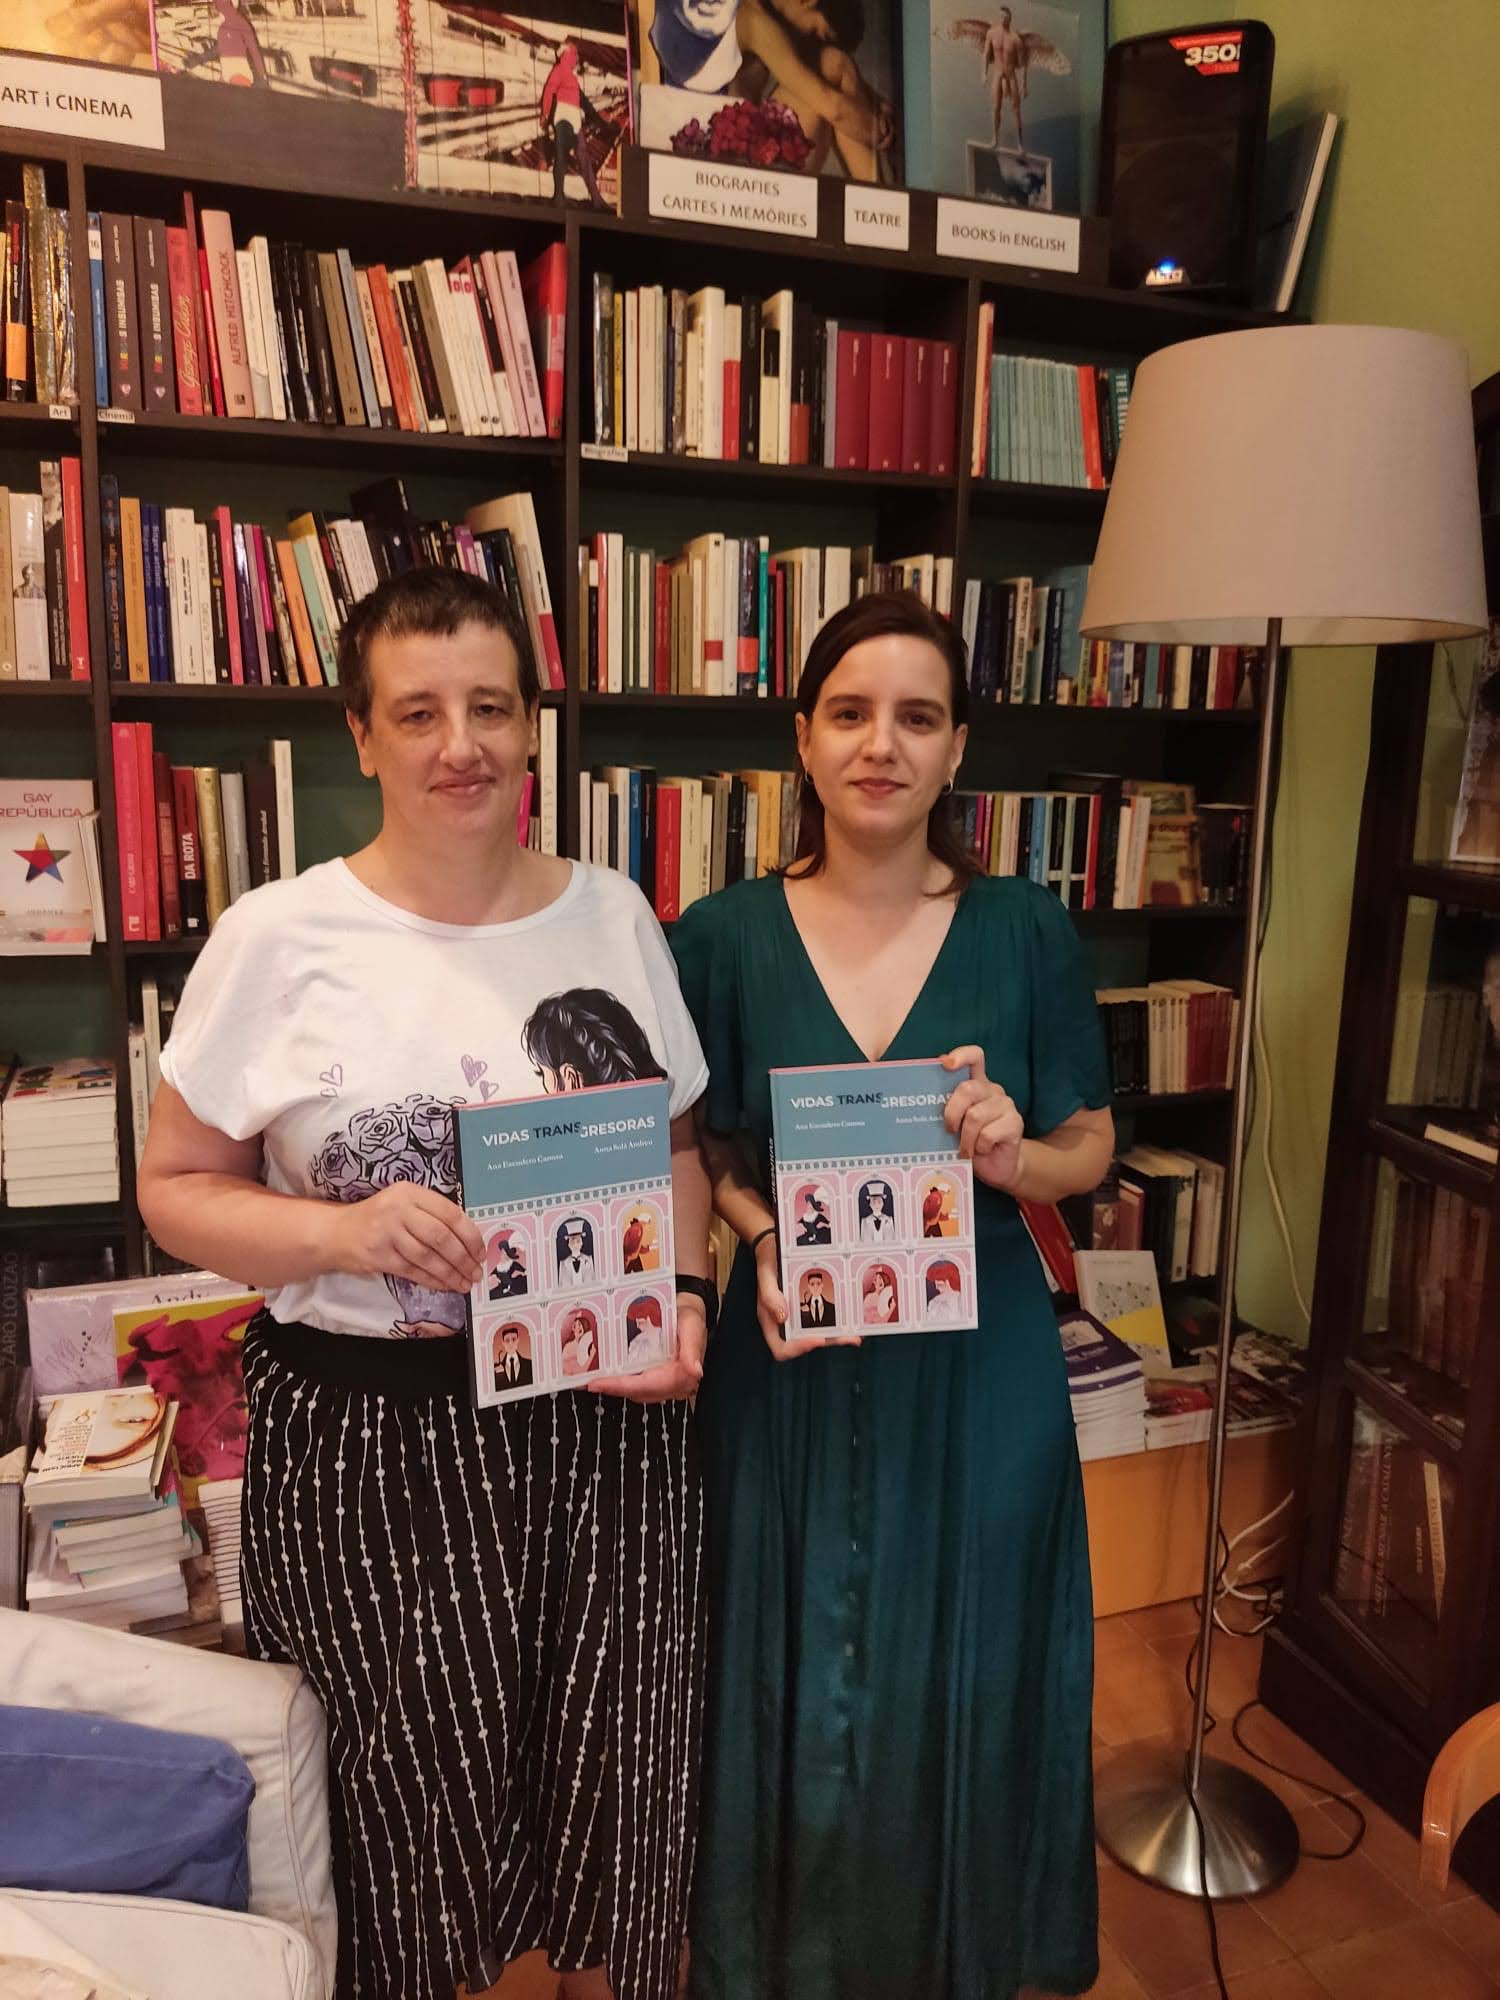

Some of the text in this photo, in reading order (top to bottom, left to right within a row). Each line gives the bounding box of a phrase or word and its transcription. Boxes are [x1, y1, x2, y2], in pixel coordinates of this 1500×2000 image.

[1184, 43, 1241, 67] 350
[1, 86, 133, 119] ART i CINEMA
[695, 170, 780, 197] BIOGRAFIES
[662, 194, 808, 228] CARTES I MEMÒRIES
[853, 209, 902, 228] TEATRE
[951, 224, 1066, 252] BOOKS in ENGLISH
[218, 251, 242, 367] ALFRED HITCHCOCK
[52, 407, 68, 417] Art
[98, 409, 134, 421] Cinema
[23, 793, 53, 803] GAY
[791, 1095, 834, 1109] VIDAS
[482, 1129, 530, 1147] VIDAS
